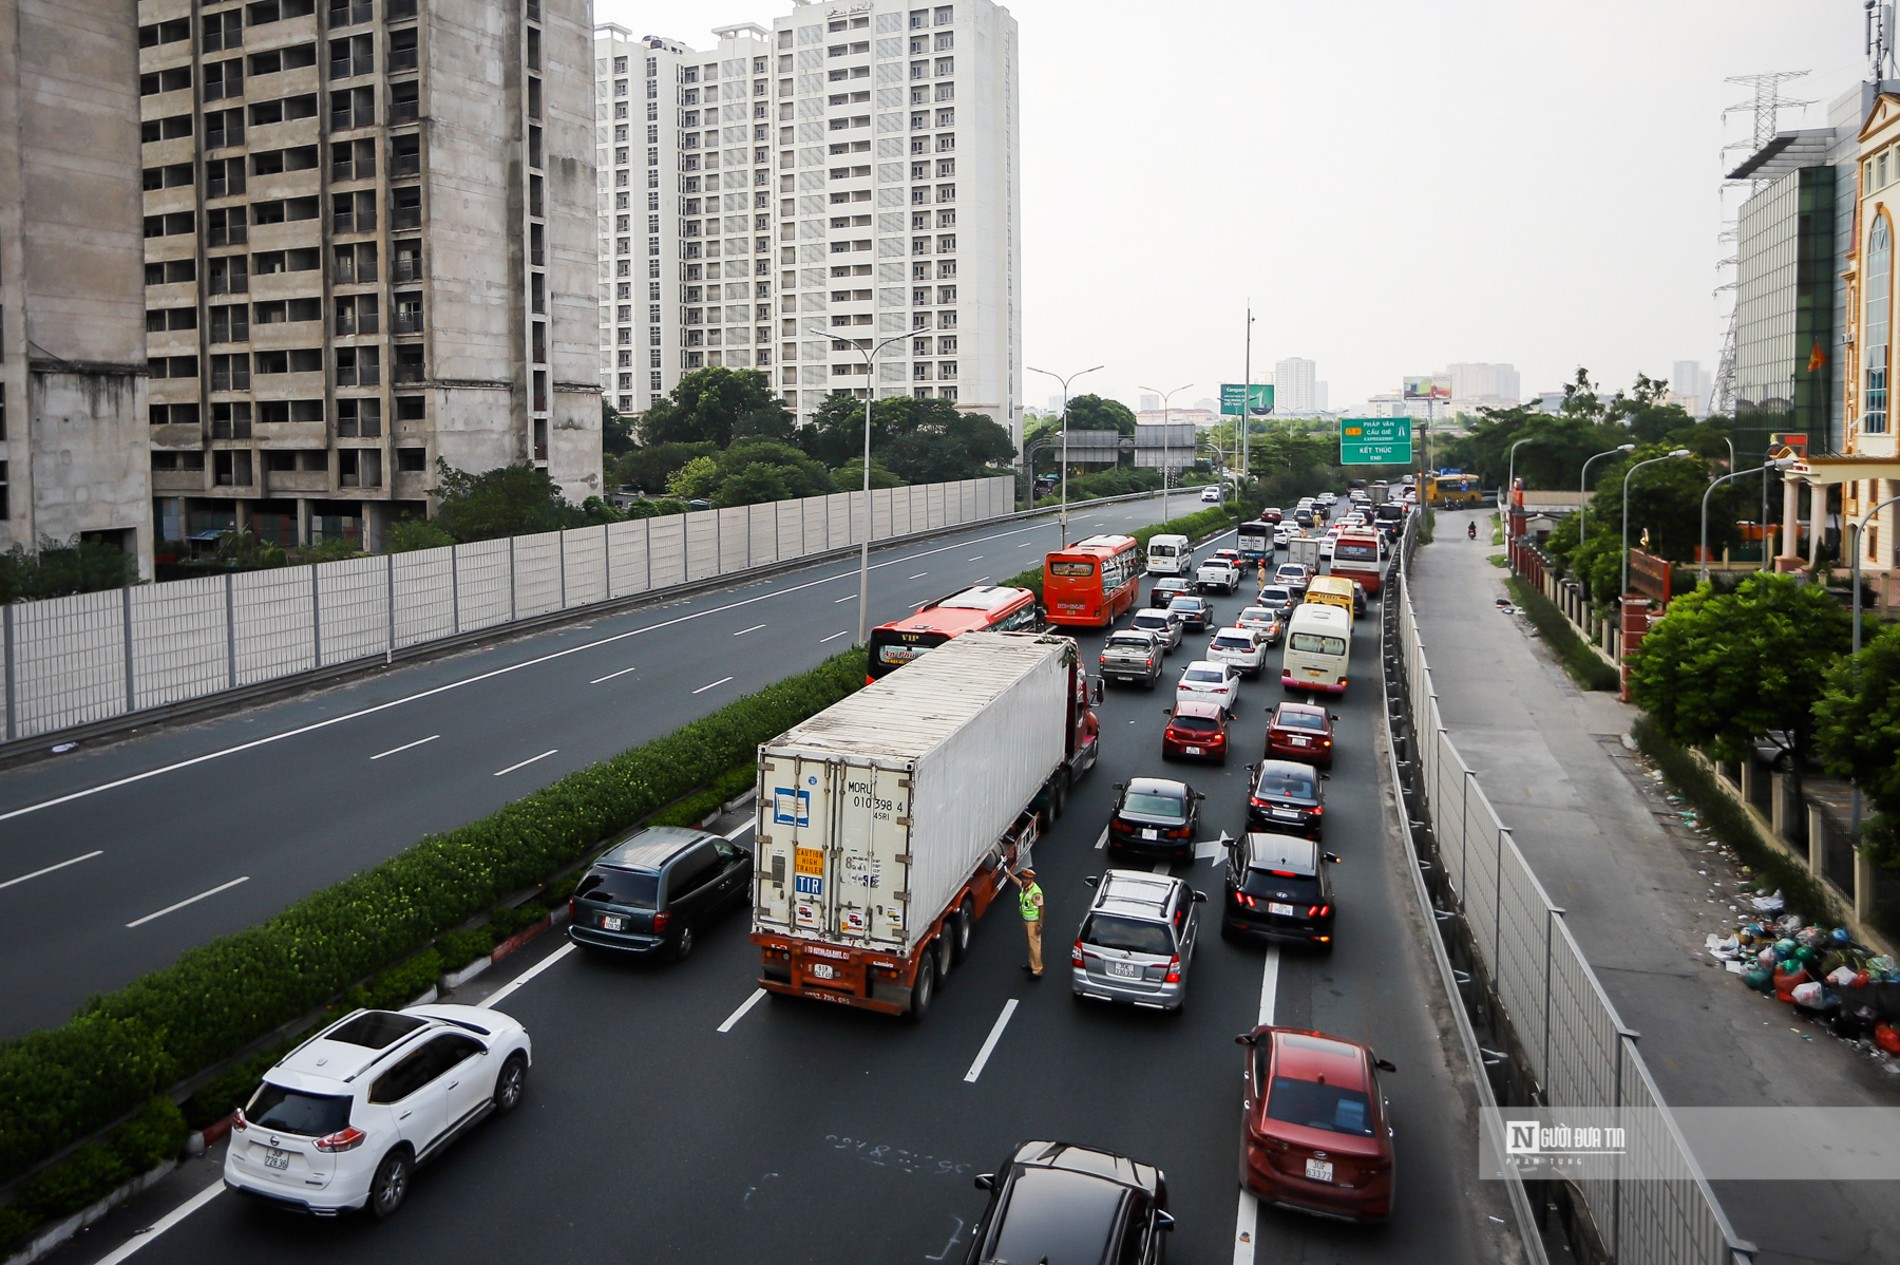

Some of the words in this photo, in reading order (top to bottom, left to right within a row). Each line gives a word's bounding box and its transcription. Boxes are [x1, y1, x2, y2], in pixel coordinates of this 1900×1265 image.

[848, 781, 873, 794] MORU
[796, 848, 823, 859] CAUTION
[801, 857, 818, 866] HIGH
[796, 865, 822, 874] TRAILER
[799, 876, 819, 893] TIR
